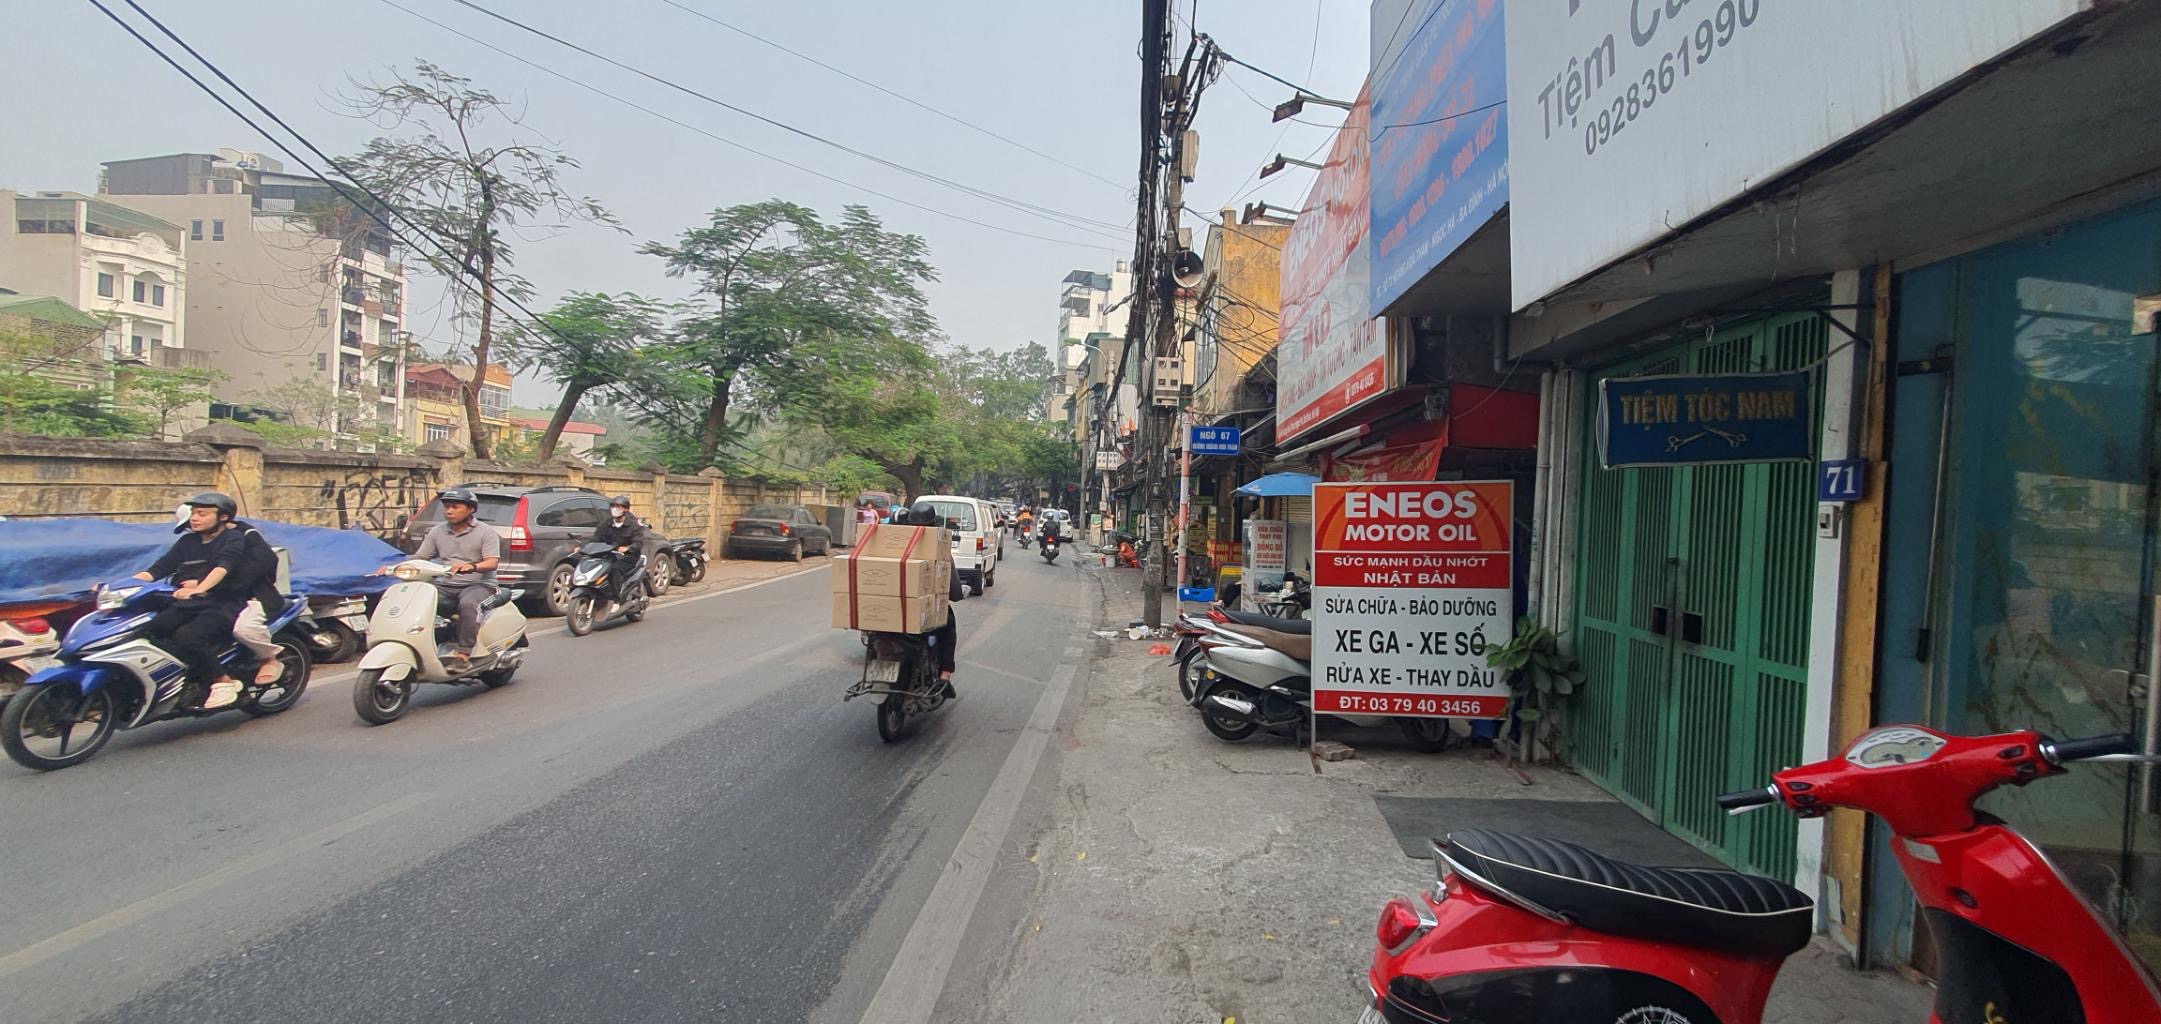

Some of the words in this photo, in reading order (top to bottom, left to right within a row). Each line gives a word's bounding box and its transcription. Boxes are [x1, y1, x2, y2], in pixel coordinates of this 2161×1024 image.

[1537, 33, 1616, 140] Tiệm
[1585, 0, 1759, 155] 0928361990
[1289, 179, 1326, 284] ENEOS
[1620, 389, 1679, 431] TIỆM
[1684, 386, 1729, 422] TÓC
[1737, 390, 1796, 419] NAM
[1221, 431, 1230, 440] 67
[1826, 467, 1856, 494] 71
[1345, 490, 1477, 519] ENEOS
[1345, 524, 1430, 541] MOTOR
[1438, 524, 1476, 541] OIL
[1333, 555, 1363, 566] SỨC
[1368, 556, 1408, 568] MẠNH
[1412, 554, 1442, 566] DẦU
[1447, 555, 1488, 567] NHỚT
[1364, 570, 1412, 587] NHẬT
[1418, 569, 1456, 585] BẢN
[1326, 594, 1354, 614] SỬA
[1358, 596, 1397, 615] CHỮA
[1409, 595, 1439, 615] BẢO
[1443, 596, 1497, 616] DƯỠNG
[1335, 629, 1362, 653] XE
[1369, 630, 1400, 654] GA
[1420, 631, 1448, 655] XE
[1455, 623, 1486, 656] SỐ
[1326, 662, 1364, 684] RỬA
[1369, 668, 1391, 685] XE
[1406, 669, 1451, 687] THAY
[1457, 664, 1495, 688] DẦU
[1339, 696, 1366, 710] ĐT:
[1369, 698, 1388, 711] 03
[1393, 699, 1412, 712] 79
[1417, 700, 1437, 712] 40
[1441, 700, 1481, 714] 3456
